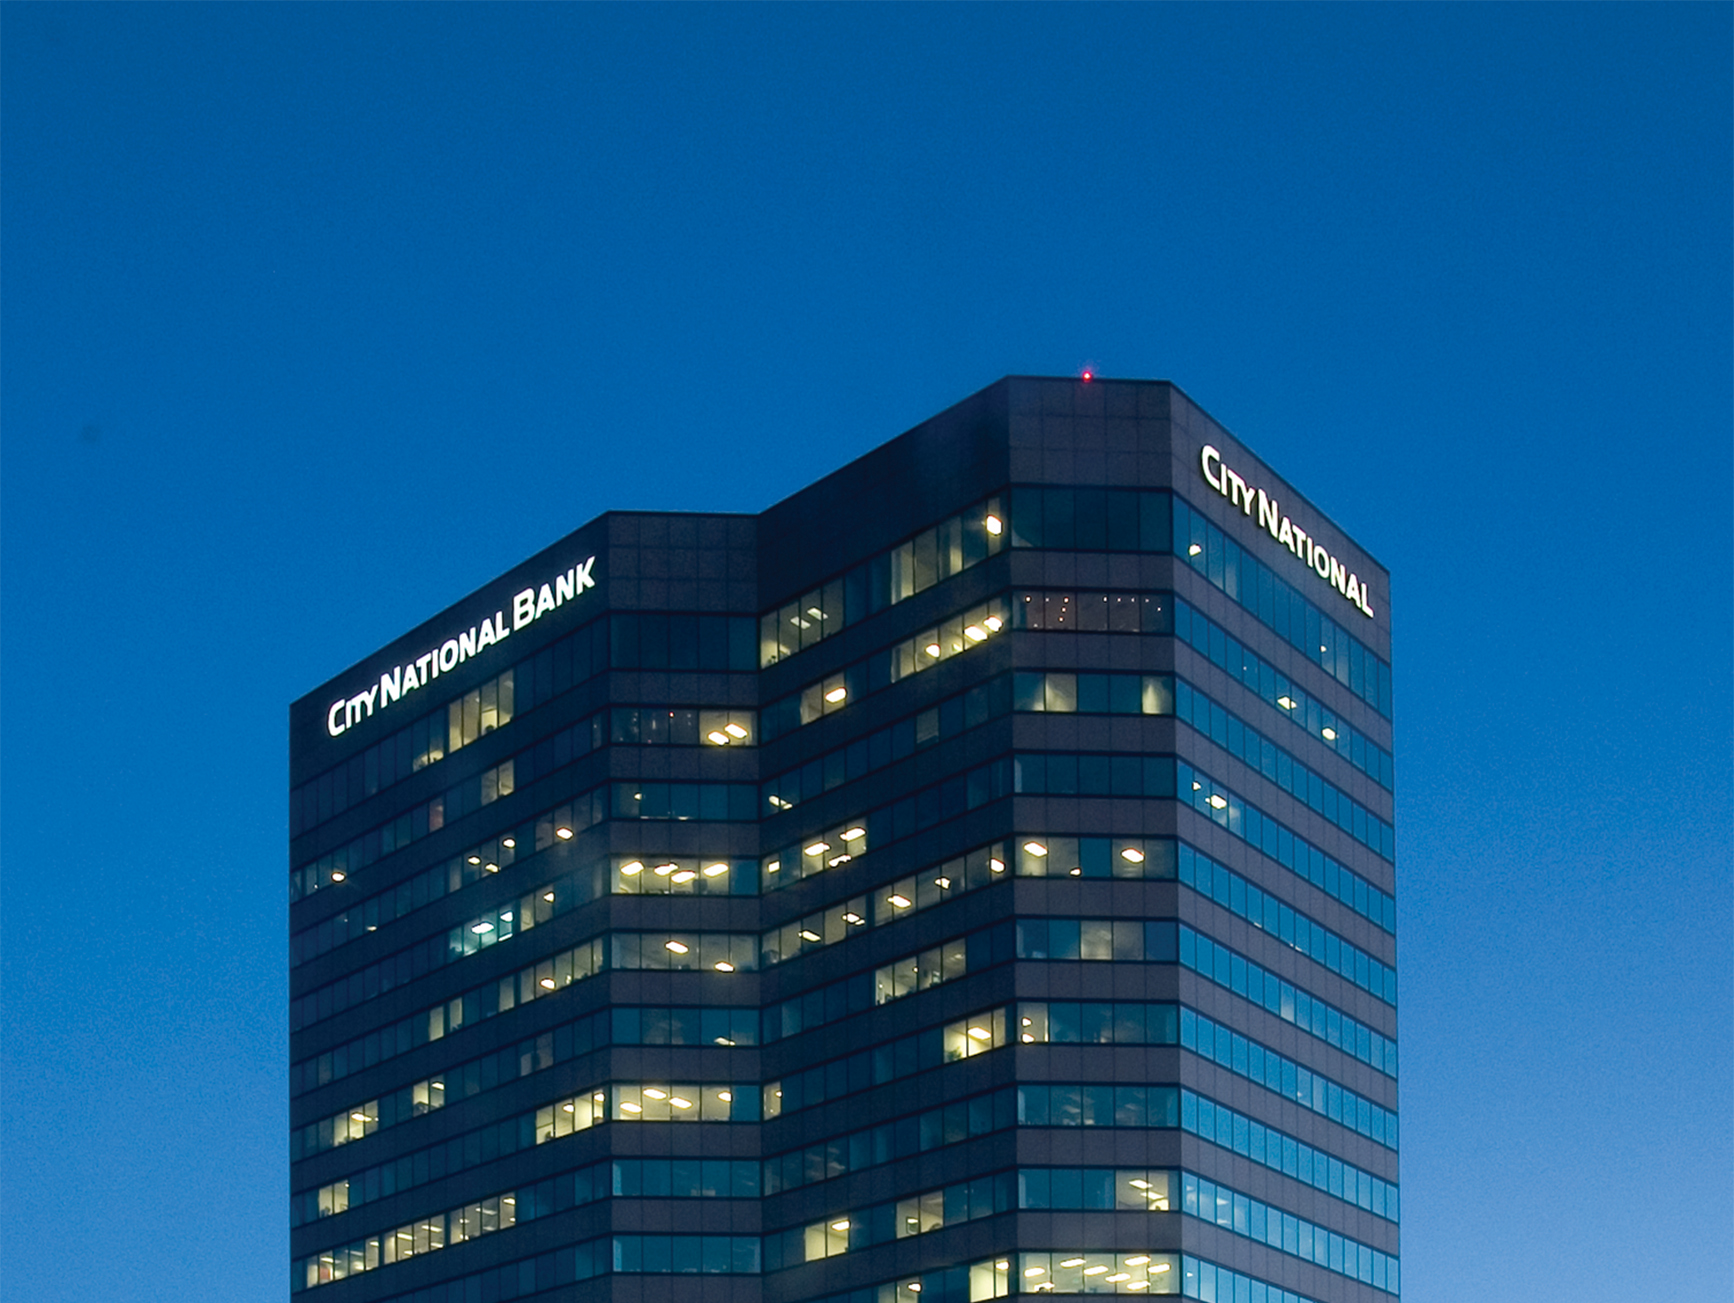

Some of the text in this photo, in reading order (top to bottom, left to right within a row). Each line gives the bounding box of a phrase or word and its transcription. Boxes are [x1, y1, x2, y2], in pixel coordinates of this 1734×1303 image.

[1200, 444, 1374, 618] CITY NATIONAL
[327, 556, 596, 737] CITY NATIONAL BANK
